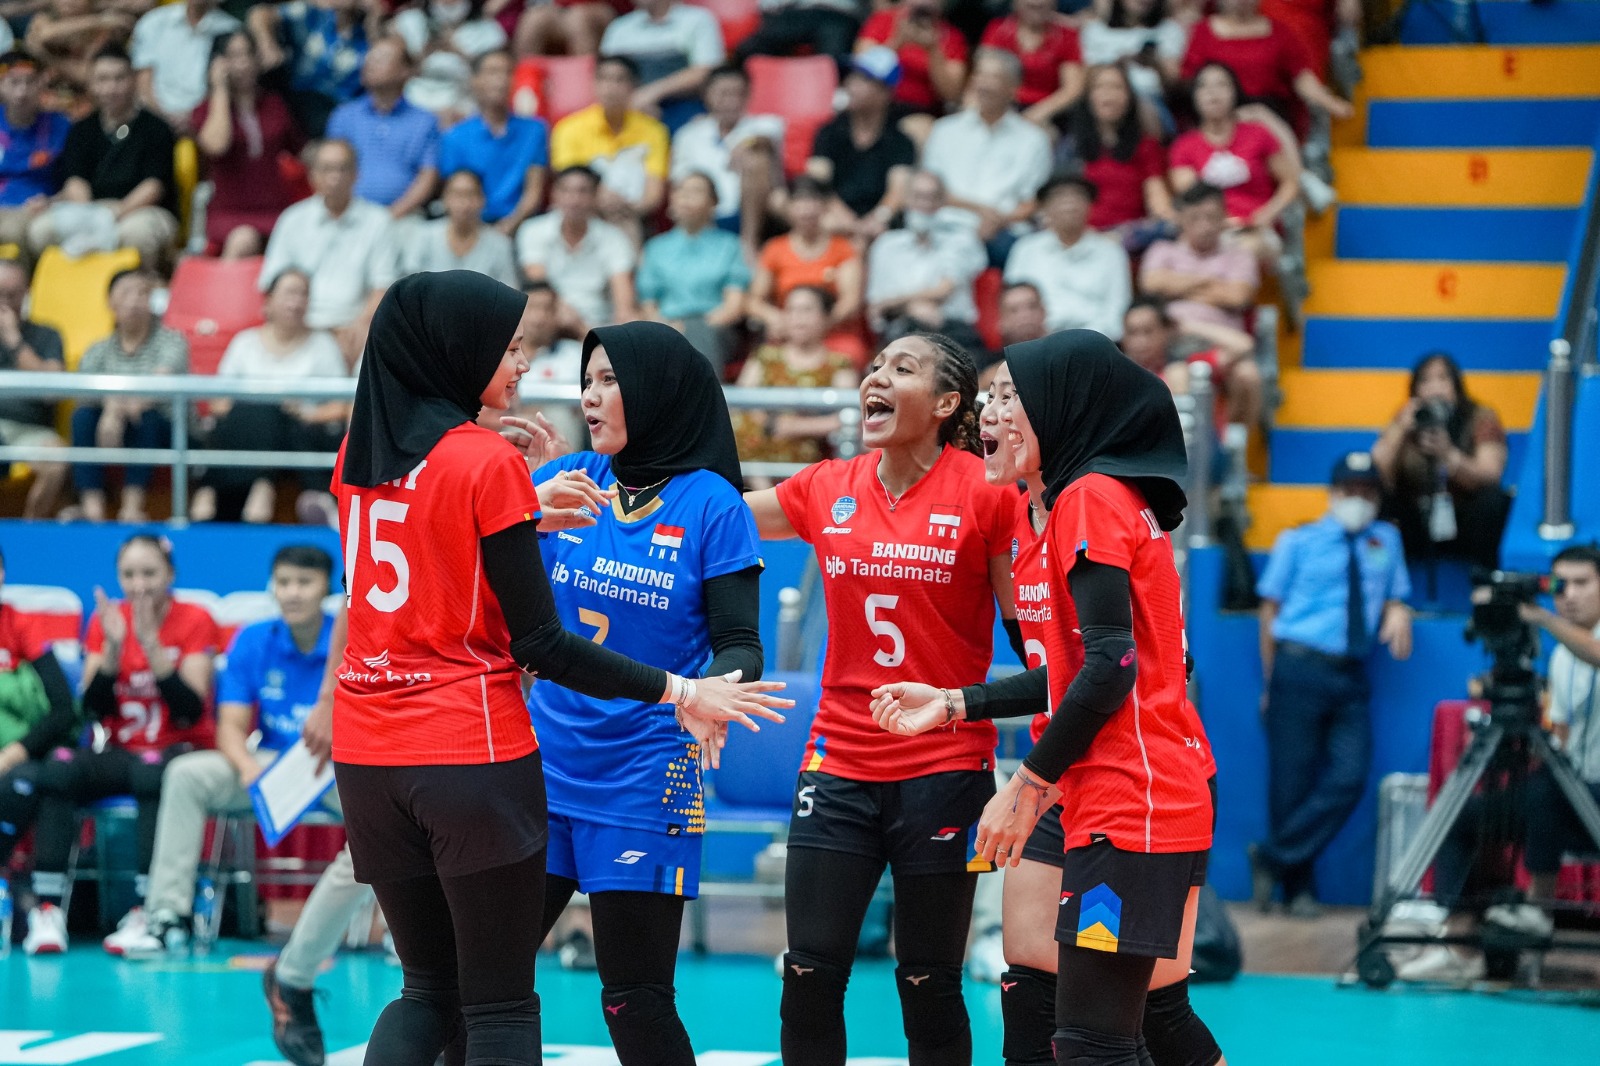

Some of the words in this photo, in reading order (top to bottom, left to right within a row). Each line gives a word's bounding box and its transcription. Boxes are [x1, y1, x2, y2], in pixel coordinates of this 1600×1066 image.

[345, 495, 410, 613] 15
[825, 555, 846, 579] bjb
[850, 558, 952, 584] Tandamata
[872, 541, 957, 566] BANDUNG
[573, 569, 670, 611] Tandamata
[592, 556, 675, 590] BANDUNG
[578, 607, 610, 645] 7
[865, 593, 905, 668] 5
[797, 785, 816, 817] 5
